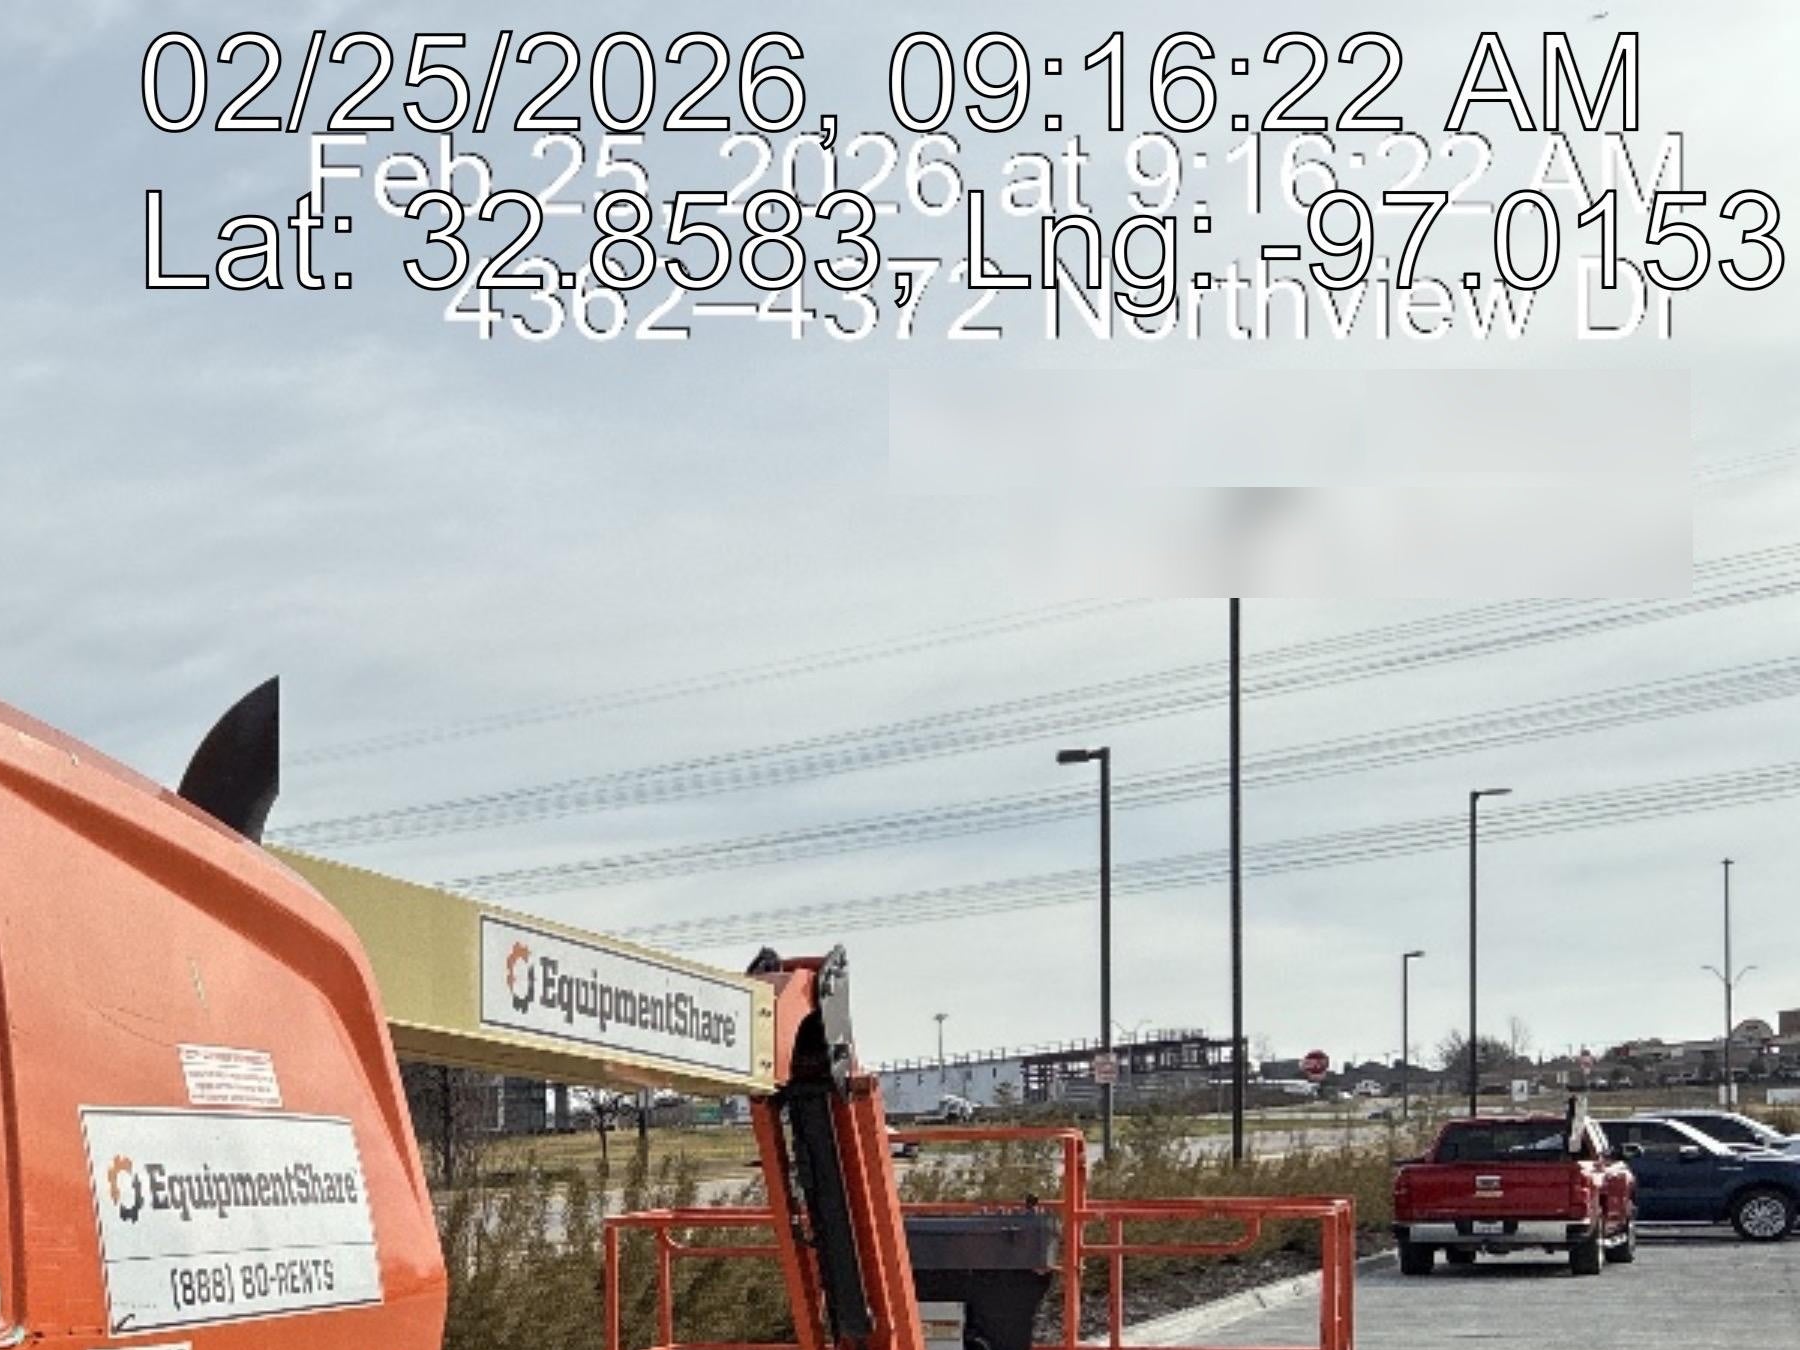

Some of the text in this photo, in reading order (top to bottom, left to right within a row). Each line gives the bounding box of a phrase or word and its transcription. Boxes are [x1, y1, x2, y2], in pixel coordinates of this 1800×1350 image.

[538, 955, 737, 1047] EquipmentShare
[145, 1160, 359, 1222] EquipmentShare
[170, 1262, 236, 1311] (888)
